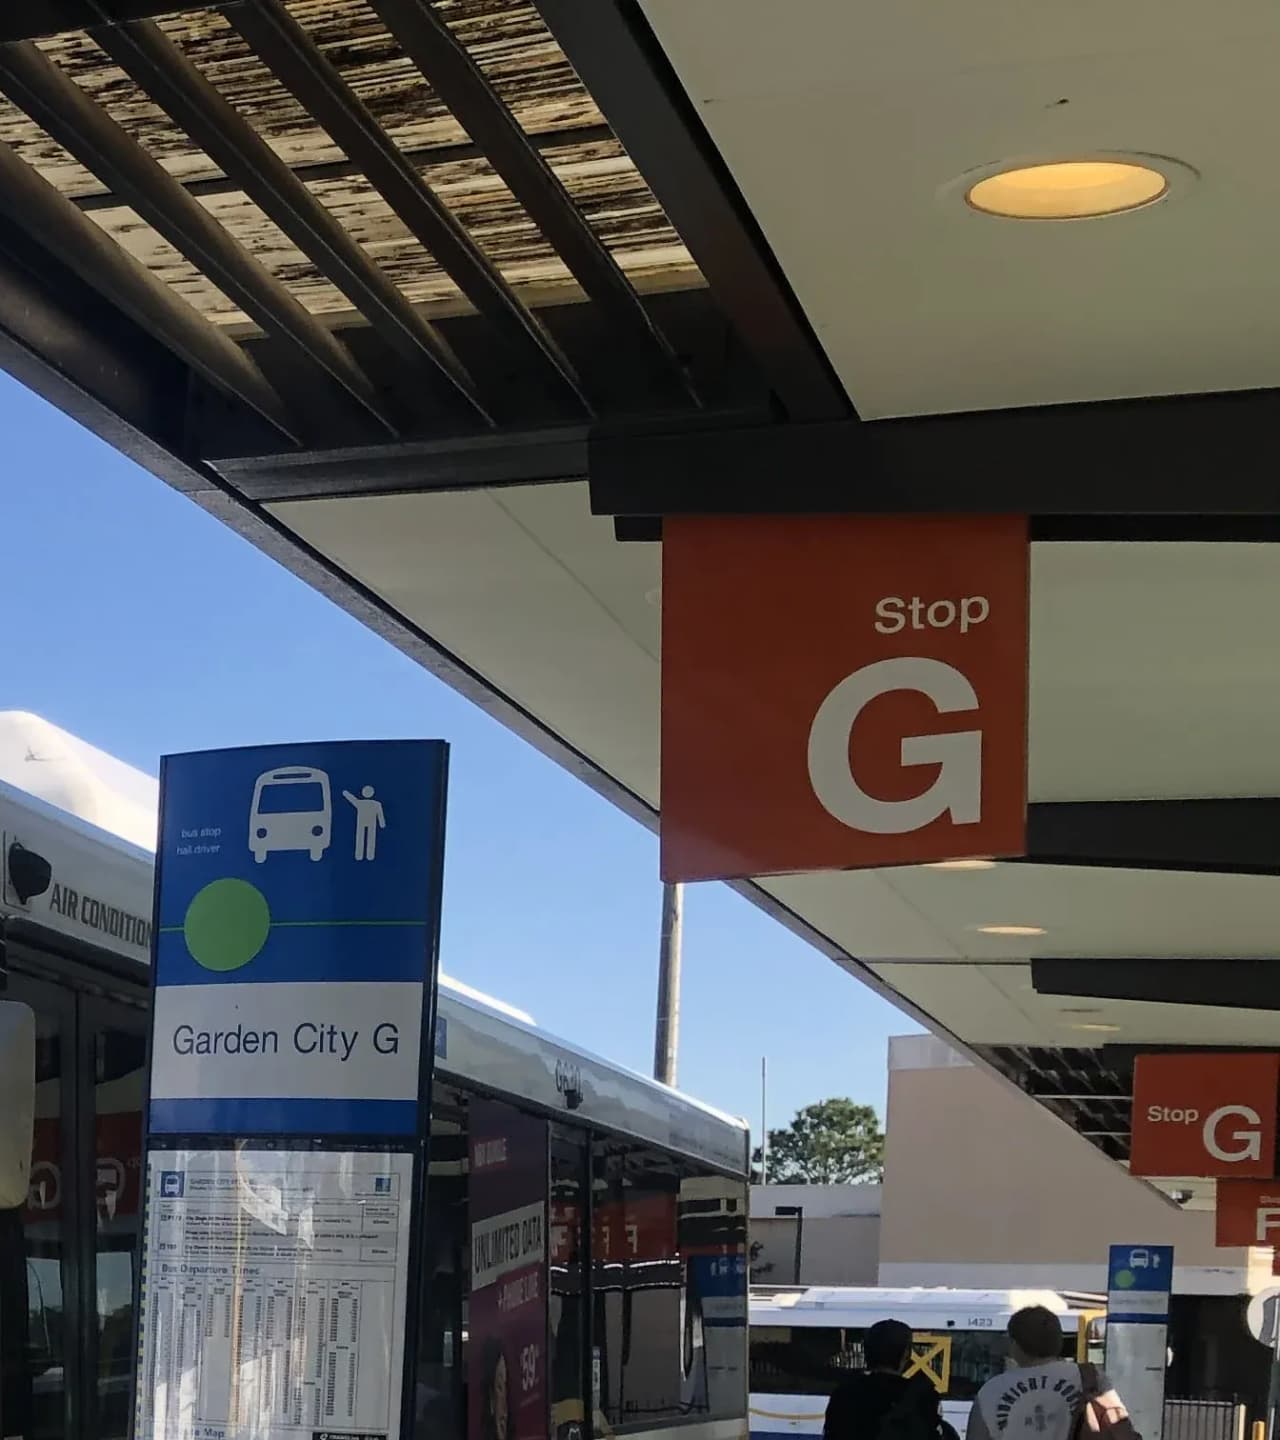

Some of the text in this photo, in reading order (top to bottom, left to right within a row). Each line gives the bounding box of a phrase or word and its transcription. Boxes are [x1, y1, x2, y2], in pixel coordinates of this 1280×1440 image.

[874, 596, 990, 634] Stop
[807, 656, 983, 834] G
[49, 883, 79, 920] AIR
[172, 1023, 400, 1061] Garden City G
[1147, 1104, 1262, 1162] Stop G
[474, 1223, 520, 1275] UNLIMITED
[522, 1213, 543, 1257] DATA
